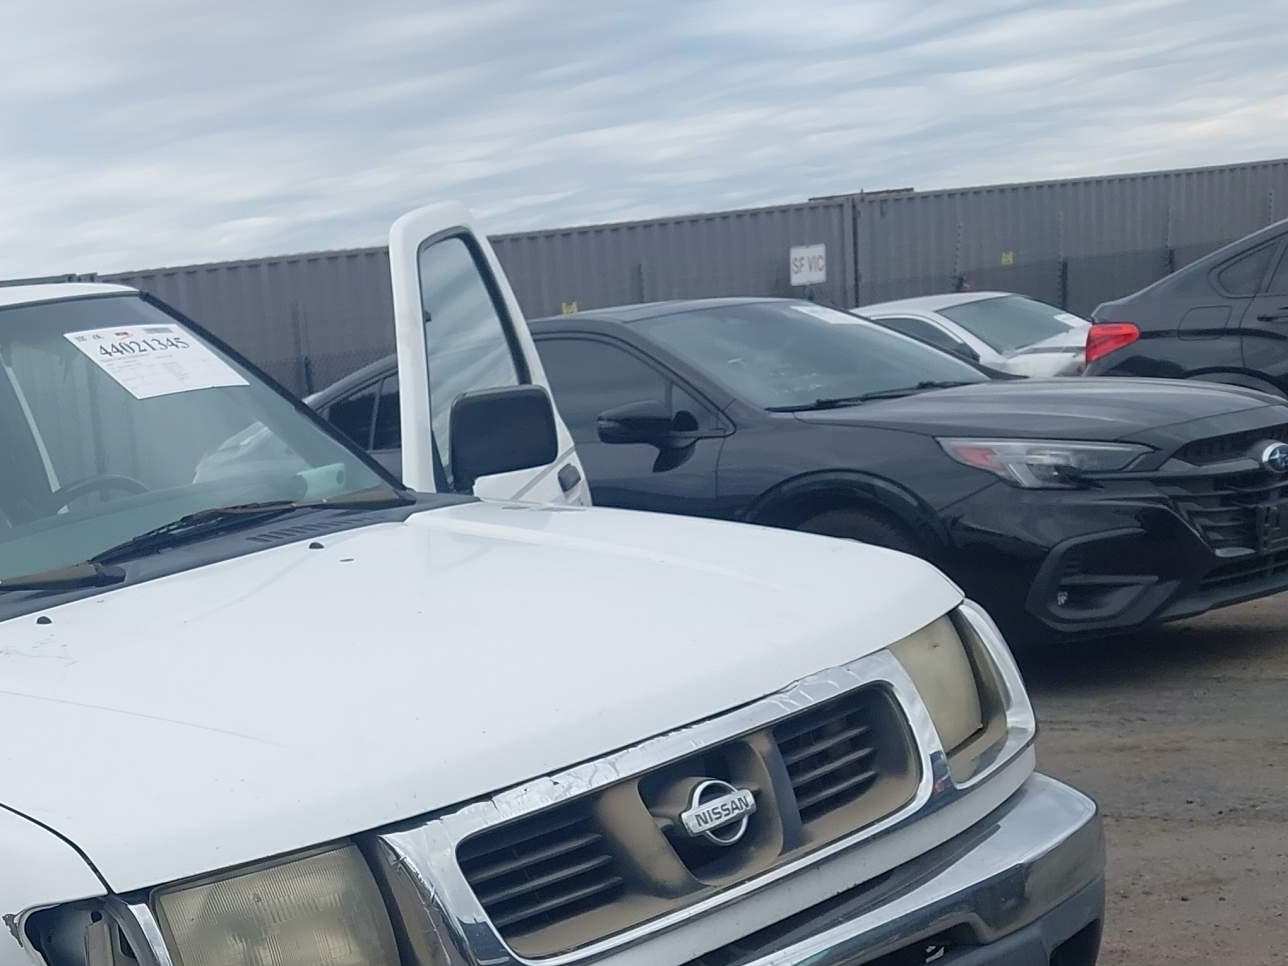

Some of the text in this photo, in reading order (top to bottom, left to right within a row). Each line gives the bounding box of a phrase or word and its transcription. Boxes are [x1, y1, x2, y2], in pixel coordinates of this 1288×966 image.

[791, 255, 825, 275] SF VIC
[99, 337, 191, 357] 44021345
[694, 796, 750, 828] NISSAN
